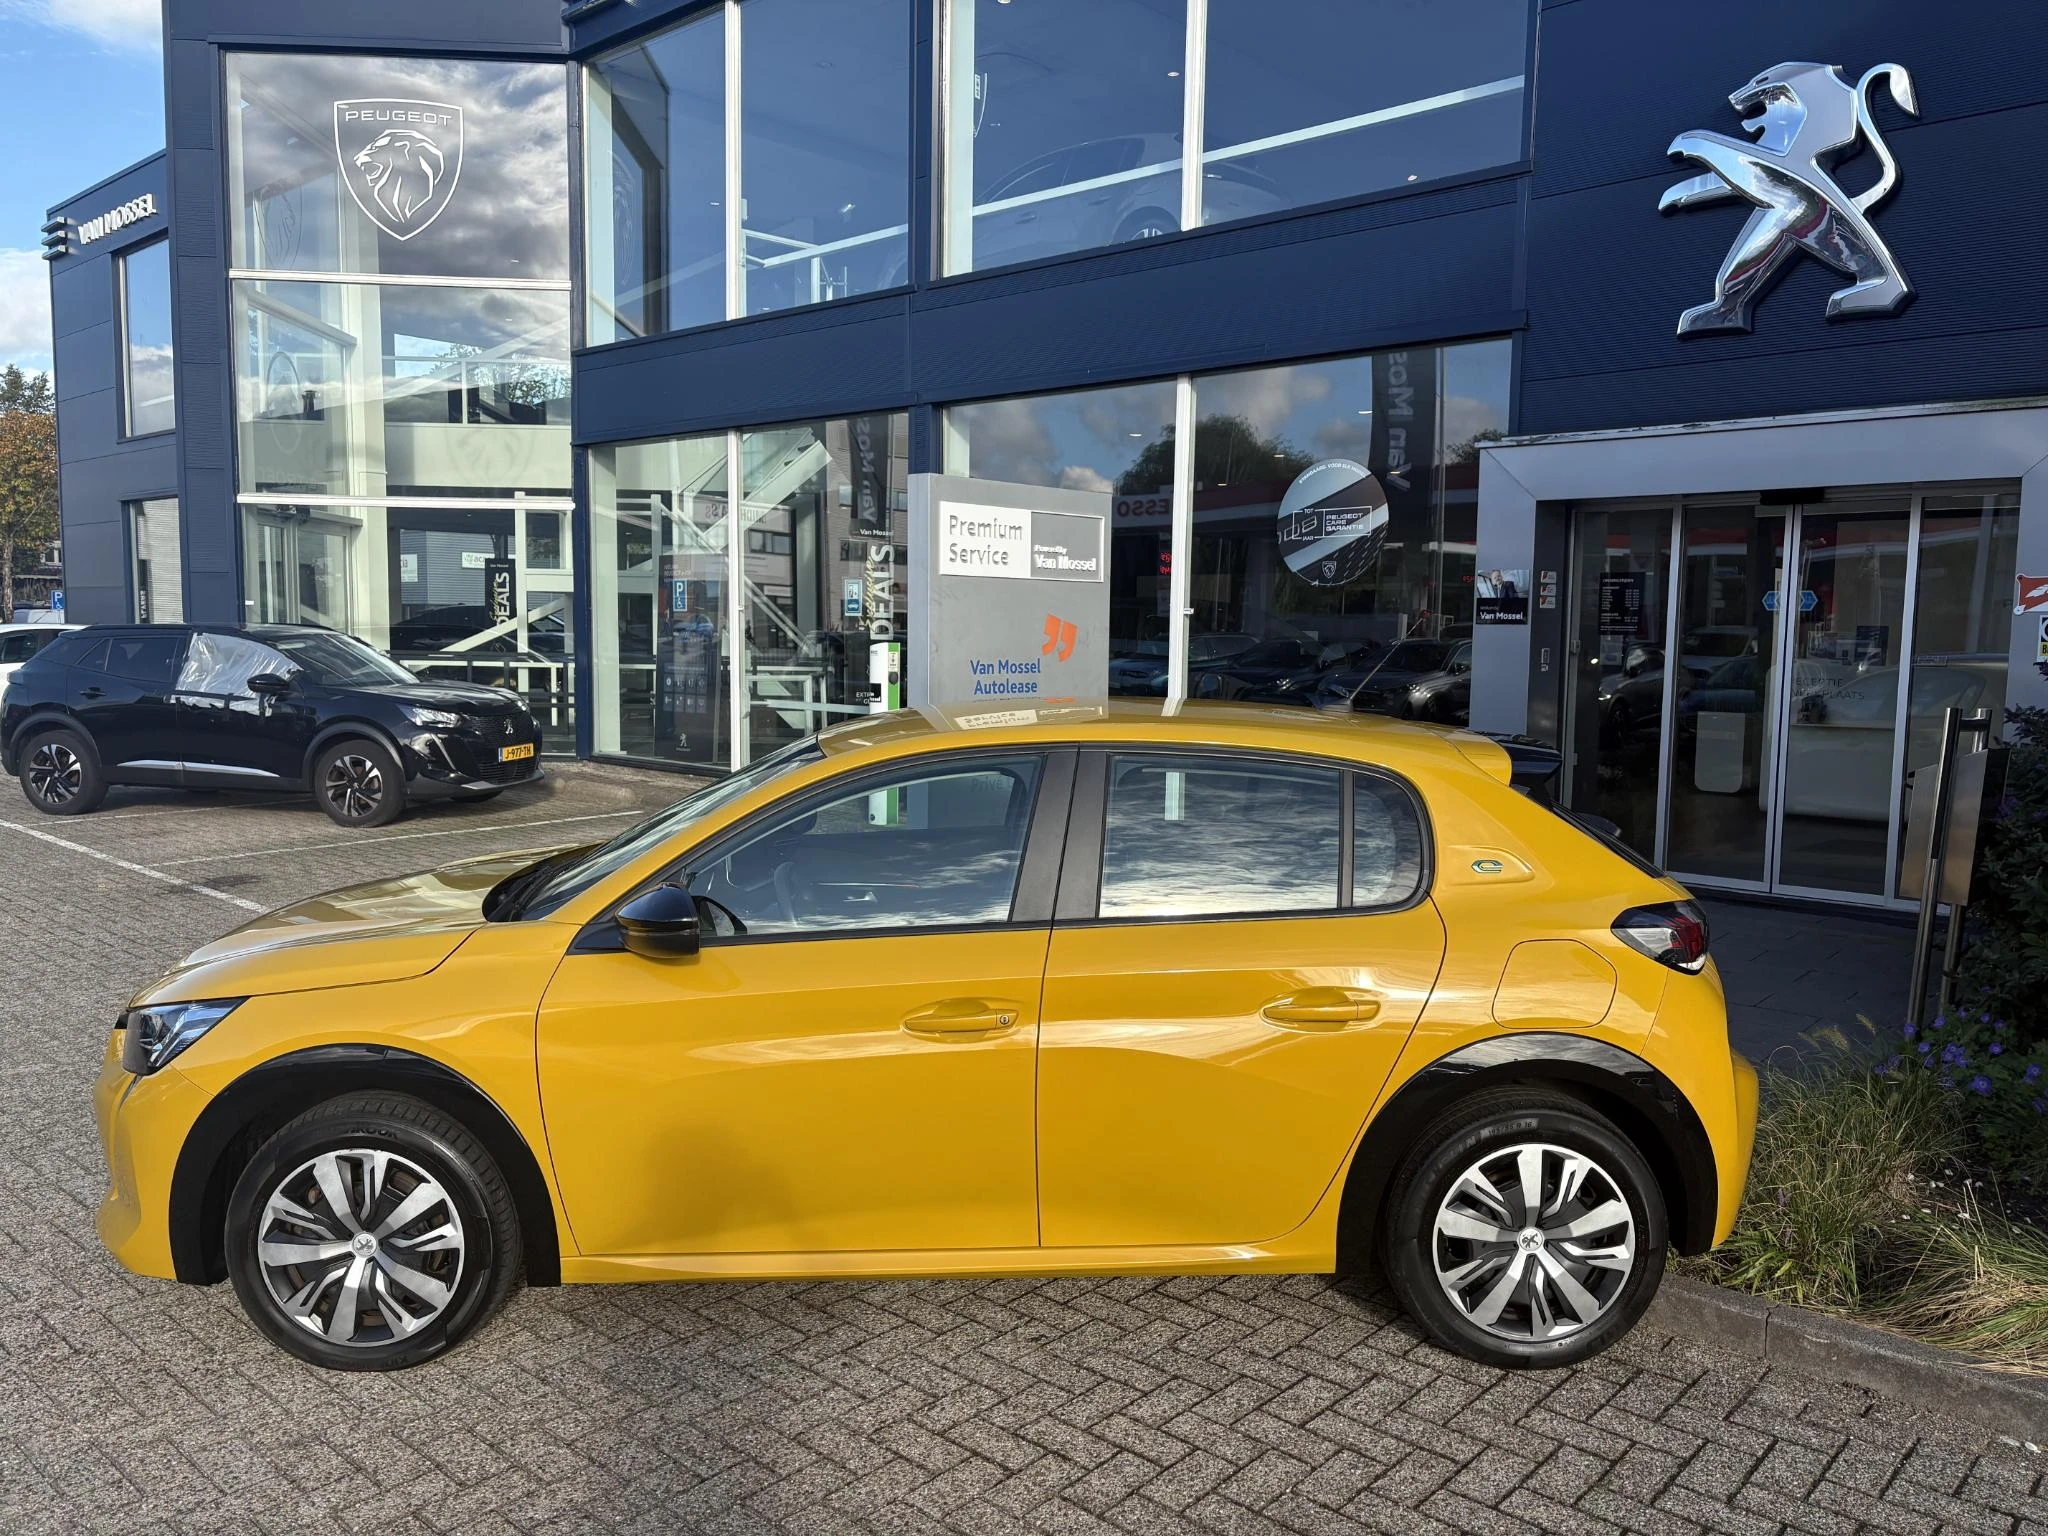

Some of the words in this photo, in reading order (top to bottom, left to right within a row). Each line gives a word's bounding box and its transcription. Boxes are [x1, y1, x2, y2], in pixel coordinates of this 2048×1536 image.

[344, 109, 452, 126] PEUGEOT
[78, 216, 104, 244] VAN
[104, 193, 157, 233] MOSSEL
[1326, 512, 1364, 520] PEUGEOT
[949, 514, 1023, 541] Premium
[1325, 524, 1364, 532] GARANTIE
[949, 542, 1009, 566] Service
[1033, 553, 1057, 569] Van
[1057, 555, 1097, 571] Mossel
[870, 544, 895, 641] DEALS
[1480, 611, 1494, 620] Van
[1495, 611, 1523, 620] Mossel
[970, 659, 995, 675] Van
[998, 657, 1041, 675] Mossel
[974, 678, 1038, 695] Autolease
